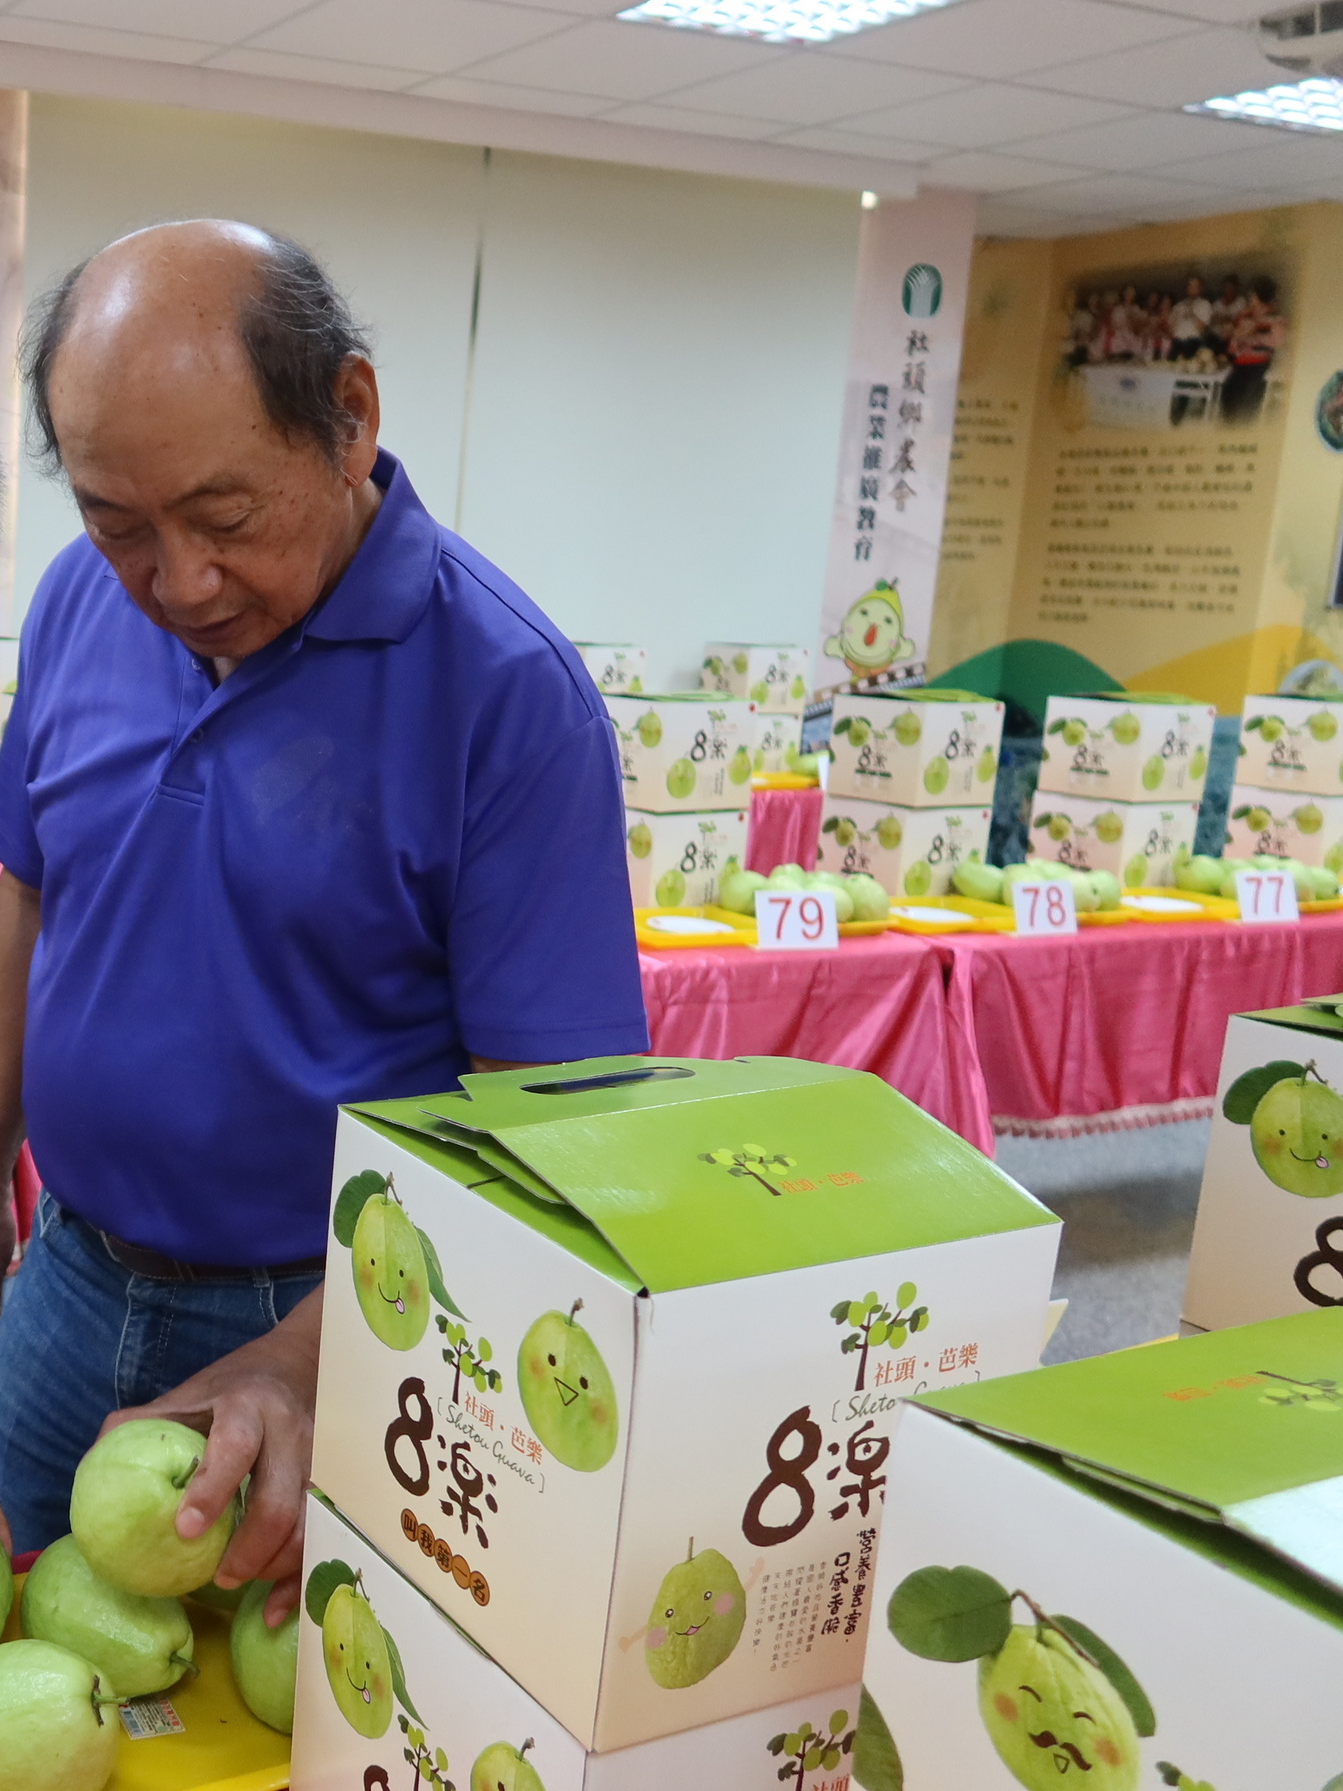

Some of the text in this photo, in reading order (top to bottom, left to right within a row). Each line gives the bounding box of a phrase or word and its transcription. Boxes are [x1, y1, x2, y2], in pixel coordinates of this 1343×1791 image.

[1022, 886, 1067, 927] 78
[1245, 876, 1285, 914] 77
[768, 896, 825, 940] 79
[845, 1393, 903, 1421] Sheto
[446, 1405, 534, 1484] Shetou Guava
[403, 1514, 489, 1603] 叫我第一名
[821, 1552, 851, 1635] 口感香脆
